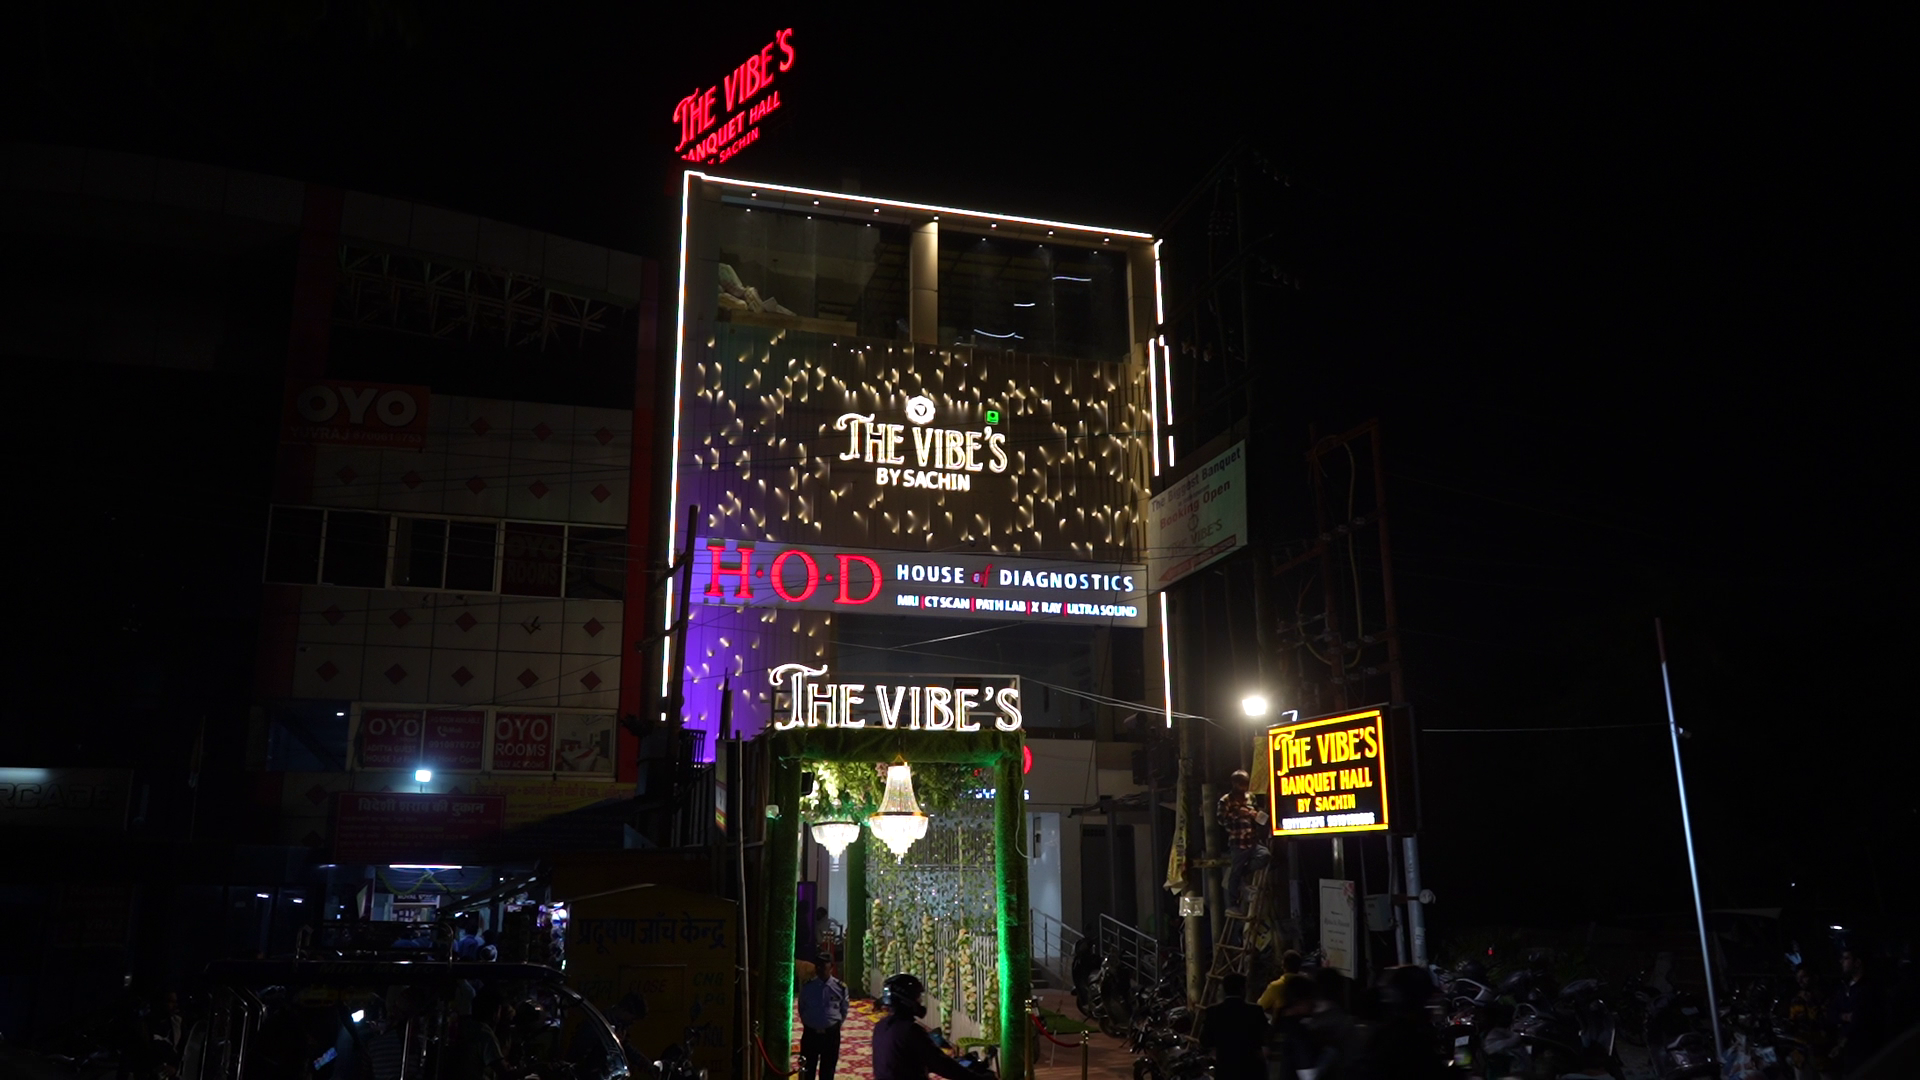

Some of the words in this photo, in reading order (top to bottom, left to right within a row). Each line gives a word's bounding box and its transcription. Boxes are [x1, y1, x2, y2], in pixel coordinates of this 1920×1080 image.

[673, 86, 718, 153] THE
[724, 27, 796, 113] VIBE'S
[680, 110, 746, 163] ANQUET
[749, 90, 781, 127] HALL
[719, 126, 760, 164] SACHIN
[297, 384, 419, 429] OYO
[834, 412, 906, 466] THE
[911, 425, 1009, 474] VIBE'S
[875, 466, 902, 487] BY
[902, 470, 972, 493] SACHIN
[1151, 499, 1166, 513] The
[1167, 473, 1200, 501] Biggest
[1201, 447, 1242, 482] Banquet
[1160, 500, 1200, 531] Booking
[1202, 480, 1231, 505] Open
[506, 534, 562, 560] OYO
[506, 560, 559, 586] ROOMS
[896, 563, 965, 585] HOUSE
[971, 563, 993, 588] of
[999, 568, 1135, 593] DIAGNOSTICS
[896, 594, 919, 608] MRI
[924, 595, 939, 609] CT
[939, 596, 971, 611] SCAN
[975, 597, 1004, 613] PATH
[1004, 599, 1027, 614] LAB
[1031, 600, 1040, 614] X
[1041, 601, 1063, 615] RAY
[1099, 604, 1138, 618] SOUND
[769, 663, 866, 731] THE
[875, 685, 1024, 732] VIBE'S
[368, 717, 421, 738] OYO
[495, 717, 549, 742] OYO
[495, 742, 547, 757] ROOMS
[1274, 730, 1313, 777] THE
[1315, 726, 1378, 765] VIBE'S
[1280, 770, 1338, 797] BANQUET
[1339, 766, 1374, 790] HALL
[357, 797, 396, 812] विदेशी
[431, 799, 448, 813] की
[451, 802, 486, 818] दुकान
[1296, 798, 1312, 813] BY
[1314, 793, 1357, 812] SACHIN
[576, 917, 638, 955] प्रदूषण
[680, 911, 728, 949] केन्द्र
[628, 978, 668, 994] CLOSE
[692, 972, 726, 988] CNG
